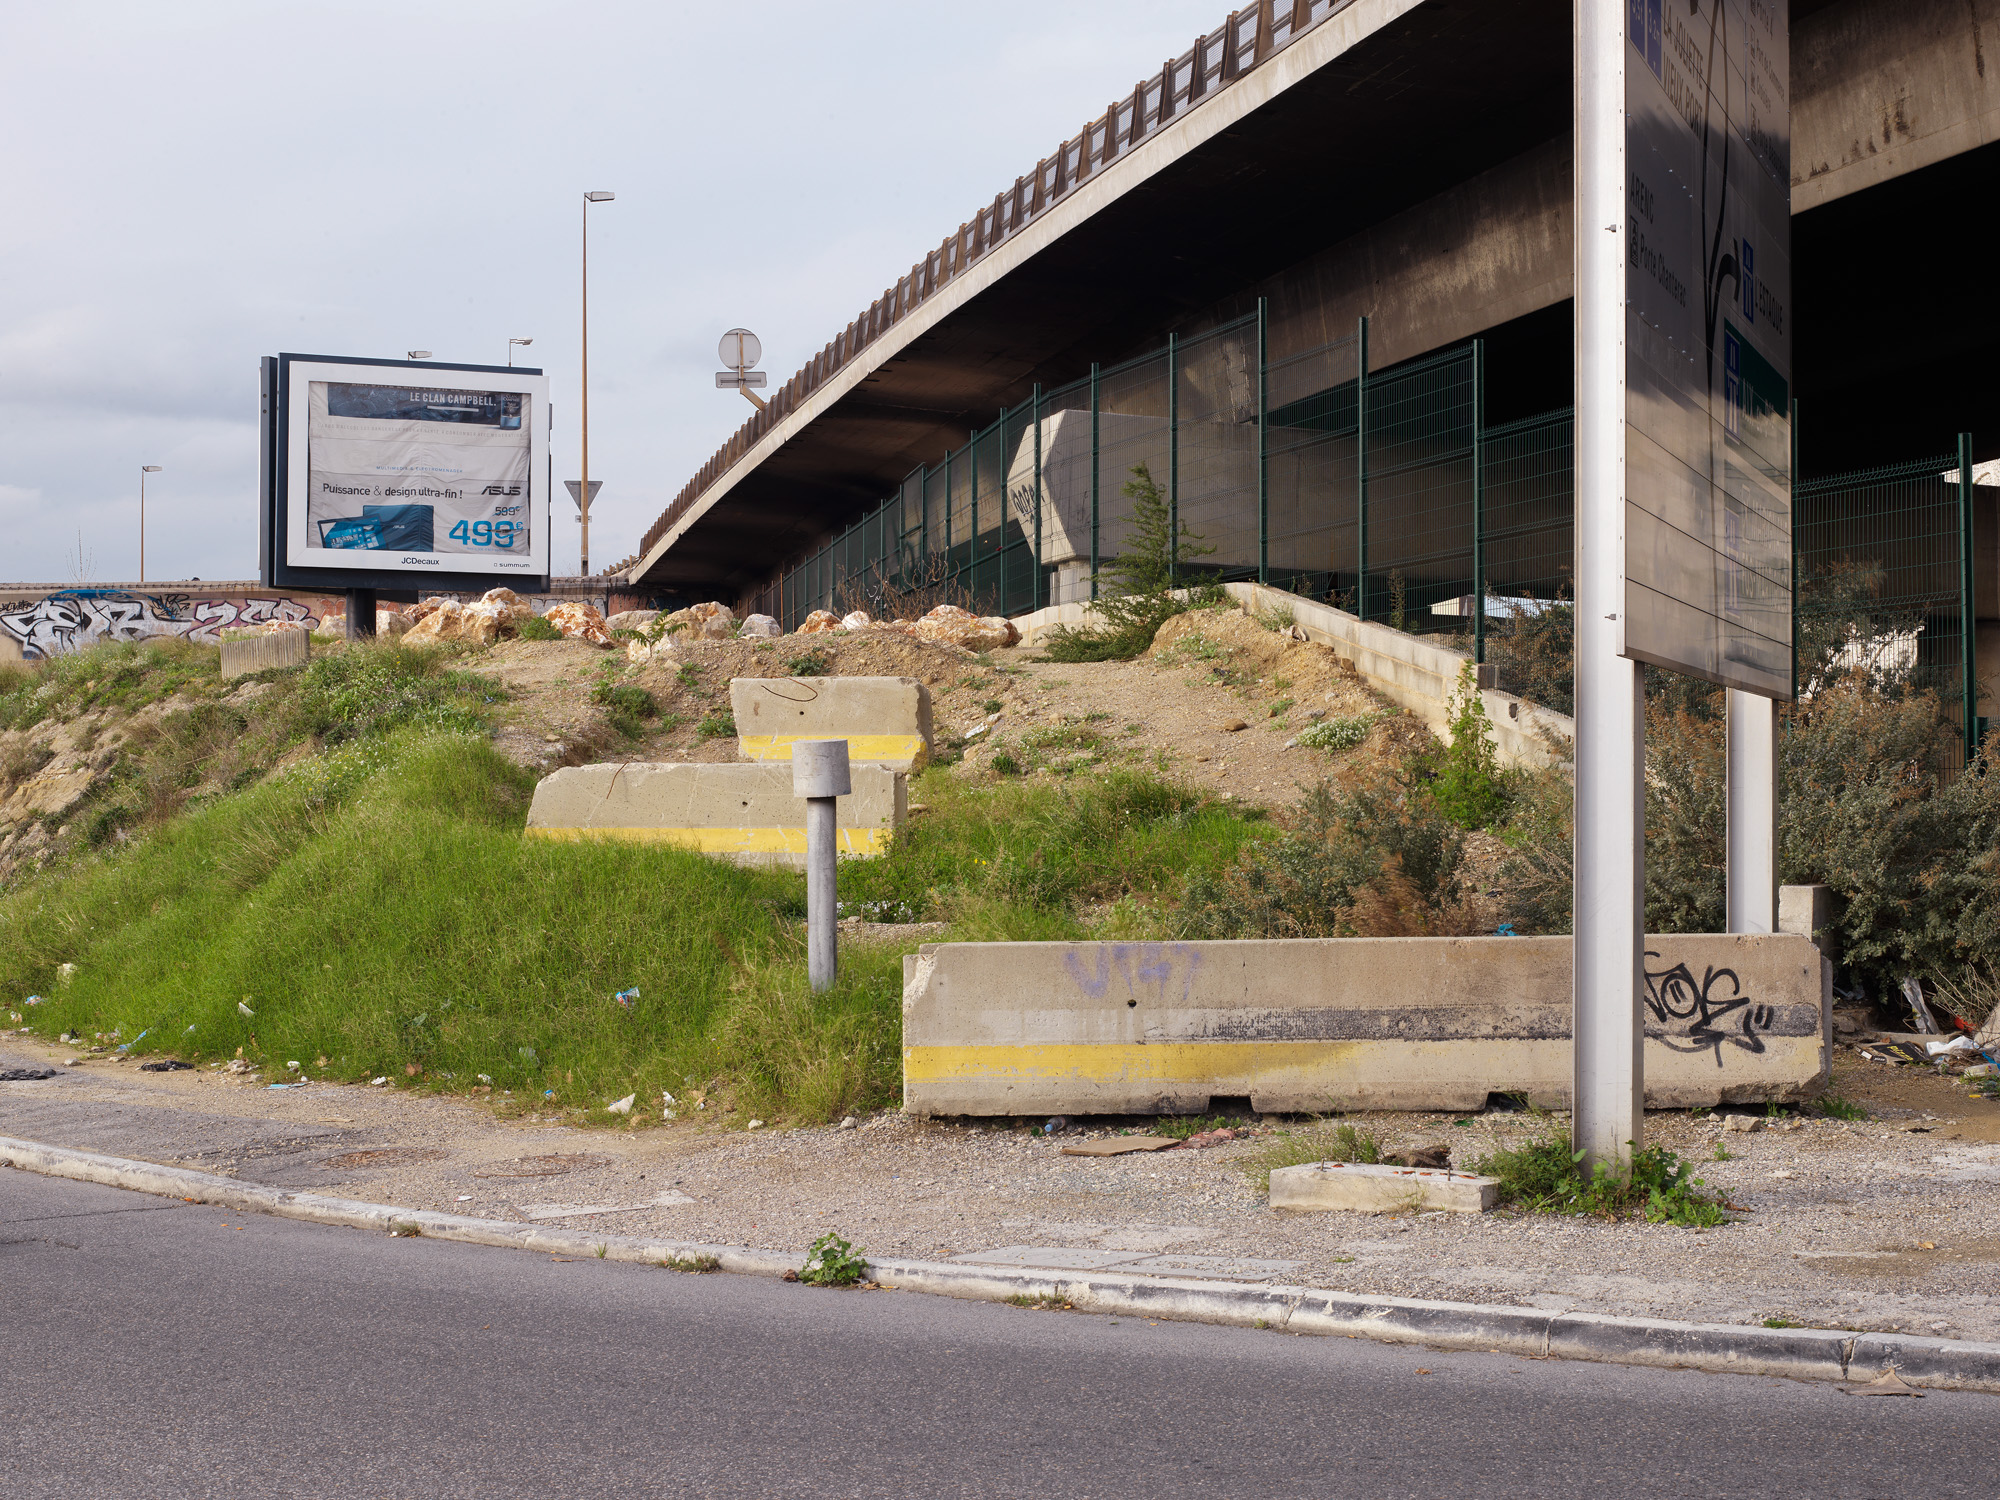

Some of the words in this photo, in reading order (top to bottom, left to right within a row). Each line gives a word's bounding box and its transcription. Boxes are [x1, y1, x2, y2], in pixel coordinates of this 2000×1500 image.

[1664, 0, 1672, 45] LA
[1674, 16, 1703, 91] JOLIETTE
[1664, 51, 1683, 117] VIEUX
[1685, 84, 1703, 142] PORT
[1631, 171, 1653, 224] ARENC
[1640, 232, 1656, 278] Porte
[1755, 275, 1782, 336] L'ESTAQUE
[410, 392, 420, 402] LE
[422, 392, 446, 403] CLAN
[448, 394, 497, 407] CAMPBELL.
[322, 482, 371, 496] Puissance
[373, 485, 382, 497] &
[384, 486, 417, 499] design
[418, 486, 457, 499] ultra-fin
[481, 486, 521, 496] ASUS
[401, 557, 440, 565] JCDecaux
